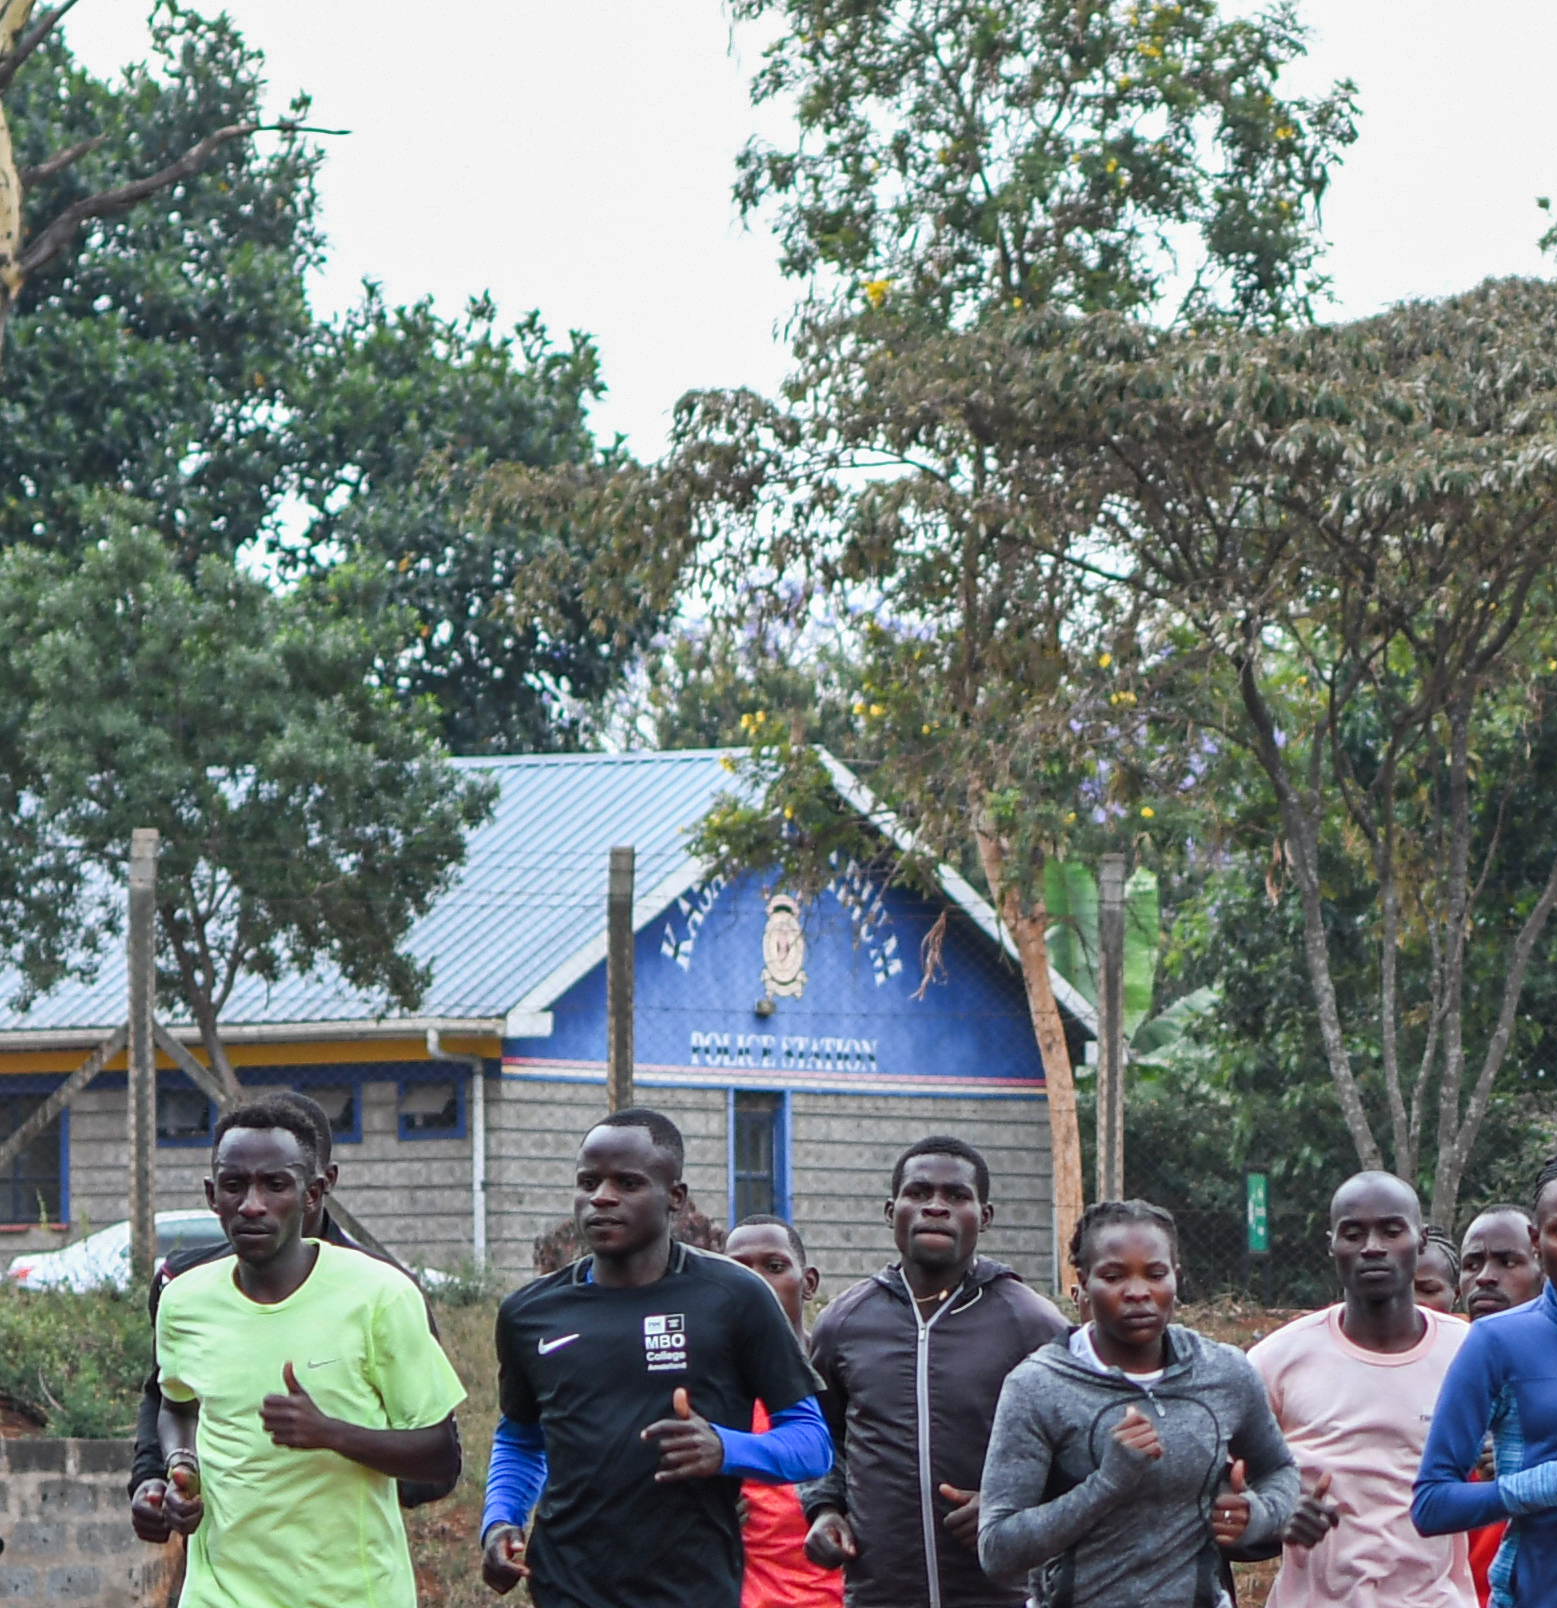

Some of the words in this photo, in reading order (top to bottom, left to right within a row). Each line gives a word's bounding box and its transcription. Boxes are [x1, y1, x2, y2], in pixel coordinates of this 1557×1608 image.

[691, 1031, 776, 1067] POLICE
[781, 1035, 878, 1072] STATION
[645, 1333, 686, 1350] MBO
